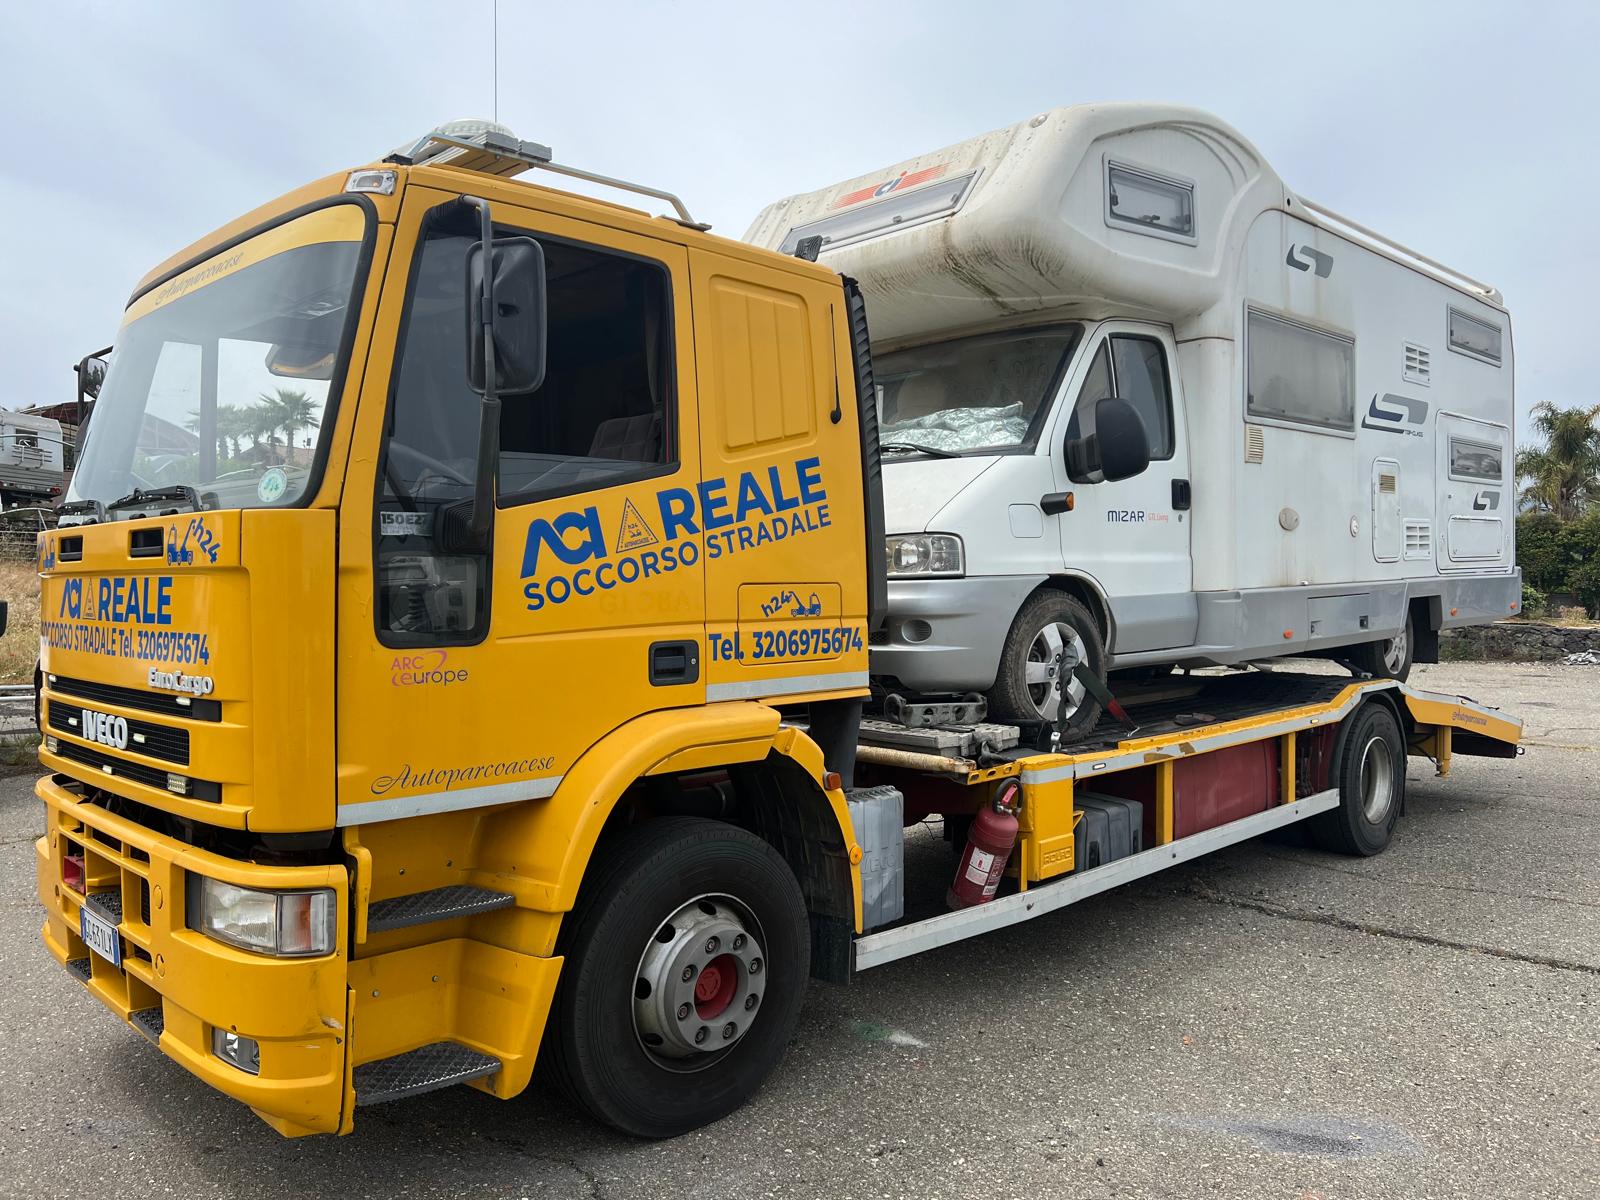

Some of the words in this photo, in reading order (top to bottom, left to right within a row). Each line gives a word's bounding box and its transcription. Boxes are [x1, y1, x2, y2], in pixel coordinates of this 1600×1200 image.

[656, 457, 827, 540] REALE
[1107, 510, 1145, 522] MIZAR
[193, 517, 222, 564] h24
[523, 541, 699, 611] SOCCORSO
[707, 504, 833, 559] STRADALE
[98, 576, 173, 625] REALE
[760, 590, 793, 618] h24
[75, 624, 117, 656] STRADALE
[118, 628, 135, 659] Tel.
[137, 630, 210, 666] 3206975674
[391, 655, 425, 671] ARC
[709, 631, 745, 661] Tel.
[752, 627, 863, 659] 3206975674
[148, 667, 214, 696] EuroCargo
[400, 669, 469, 687] europe
[82, 709, 128, 750] IVECO
[370, 755, 556, 796] Autoparcoacese
